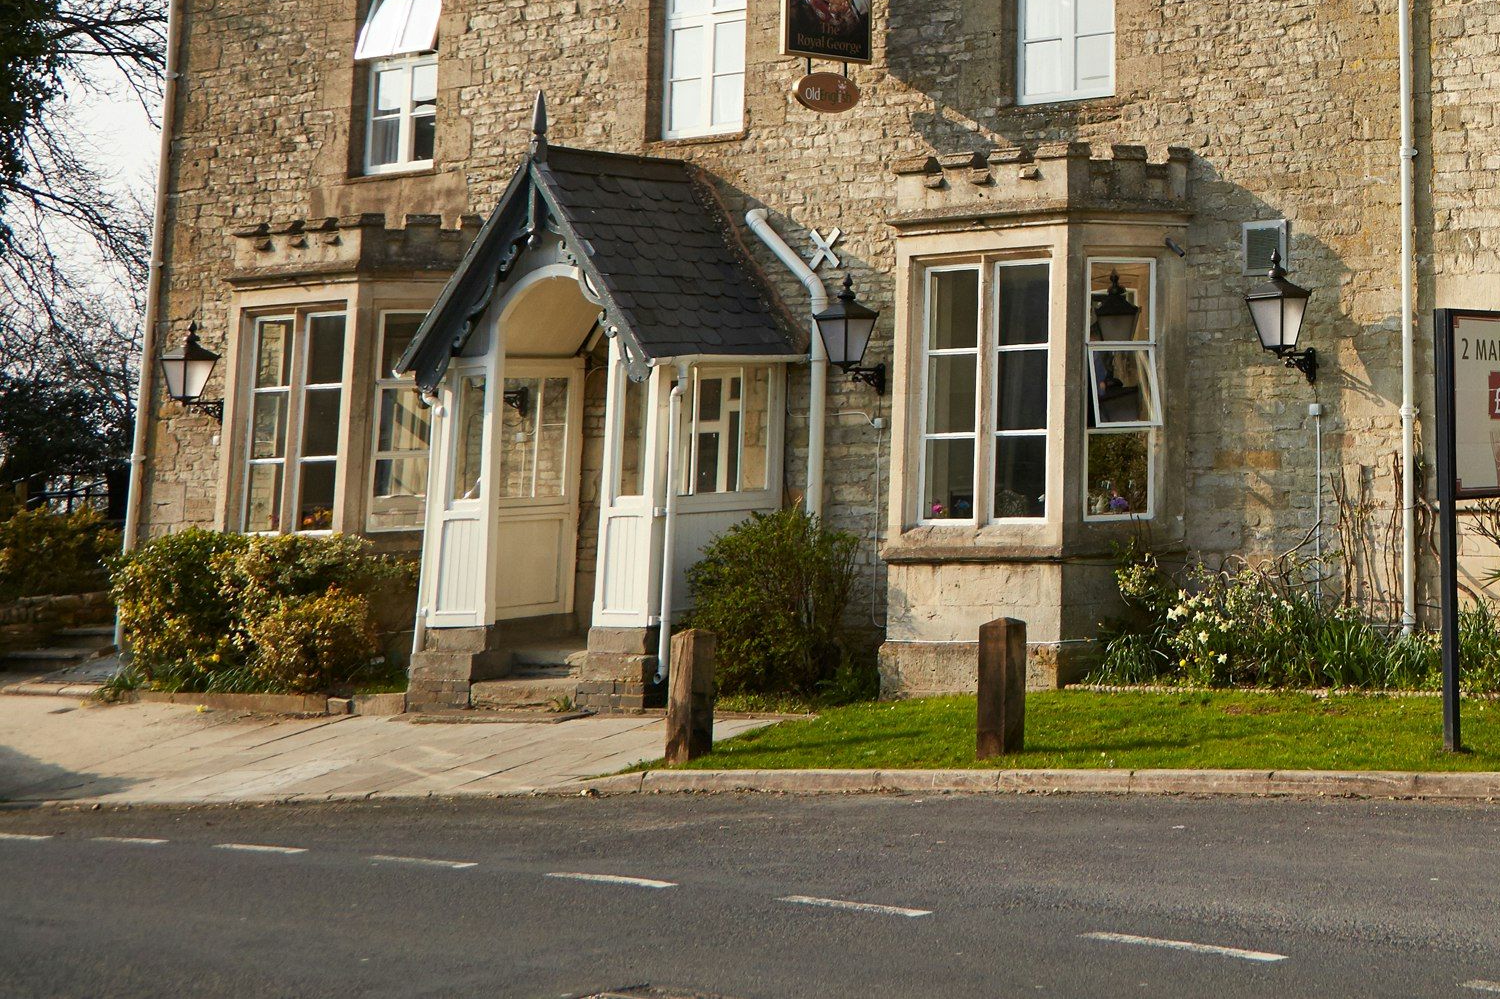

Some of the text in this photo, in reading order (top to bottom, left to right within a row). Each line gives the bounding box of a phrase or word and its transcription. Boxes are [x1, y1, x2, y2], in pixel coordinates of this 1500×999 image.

[819, 22, 840, 35] The
[797, 33, 861, 54] Royal George
[1461, 338, 1469, 360] 2
